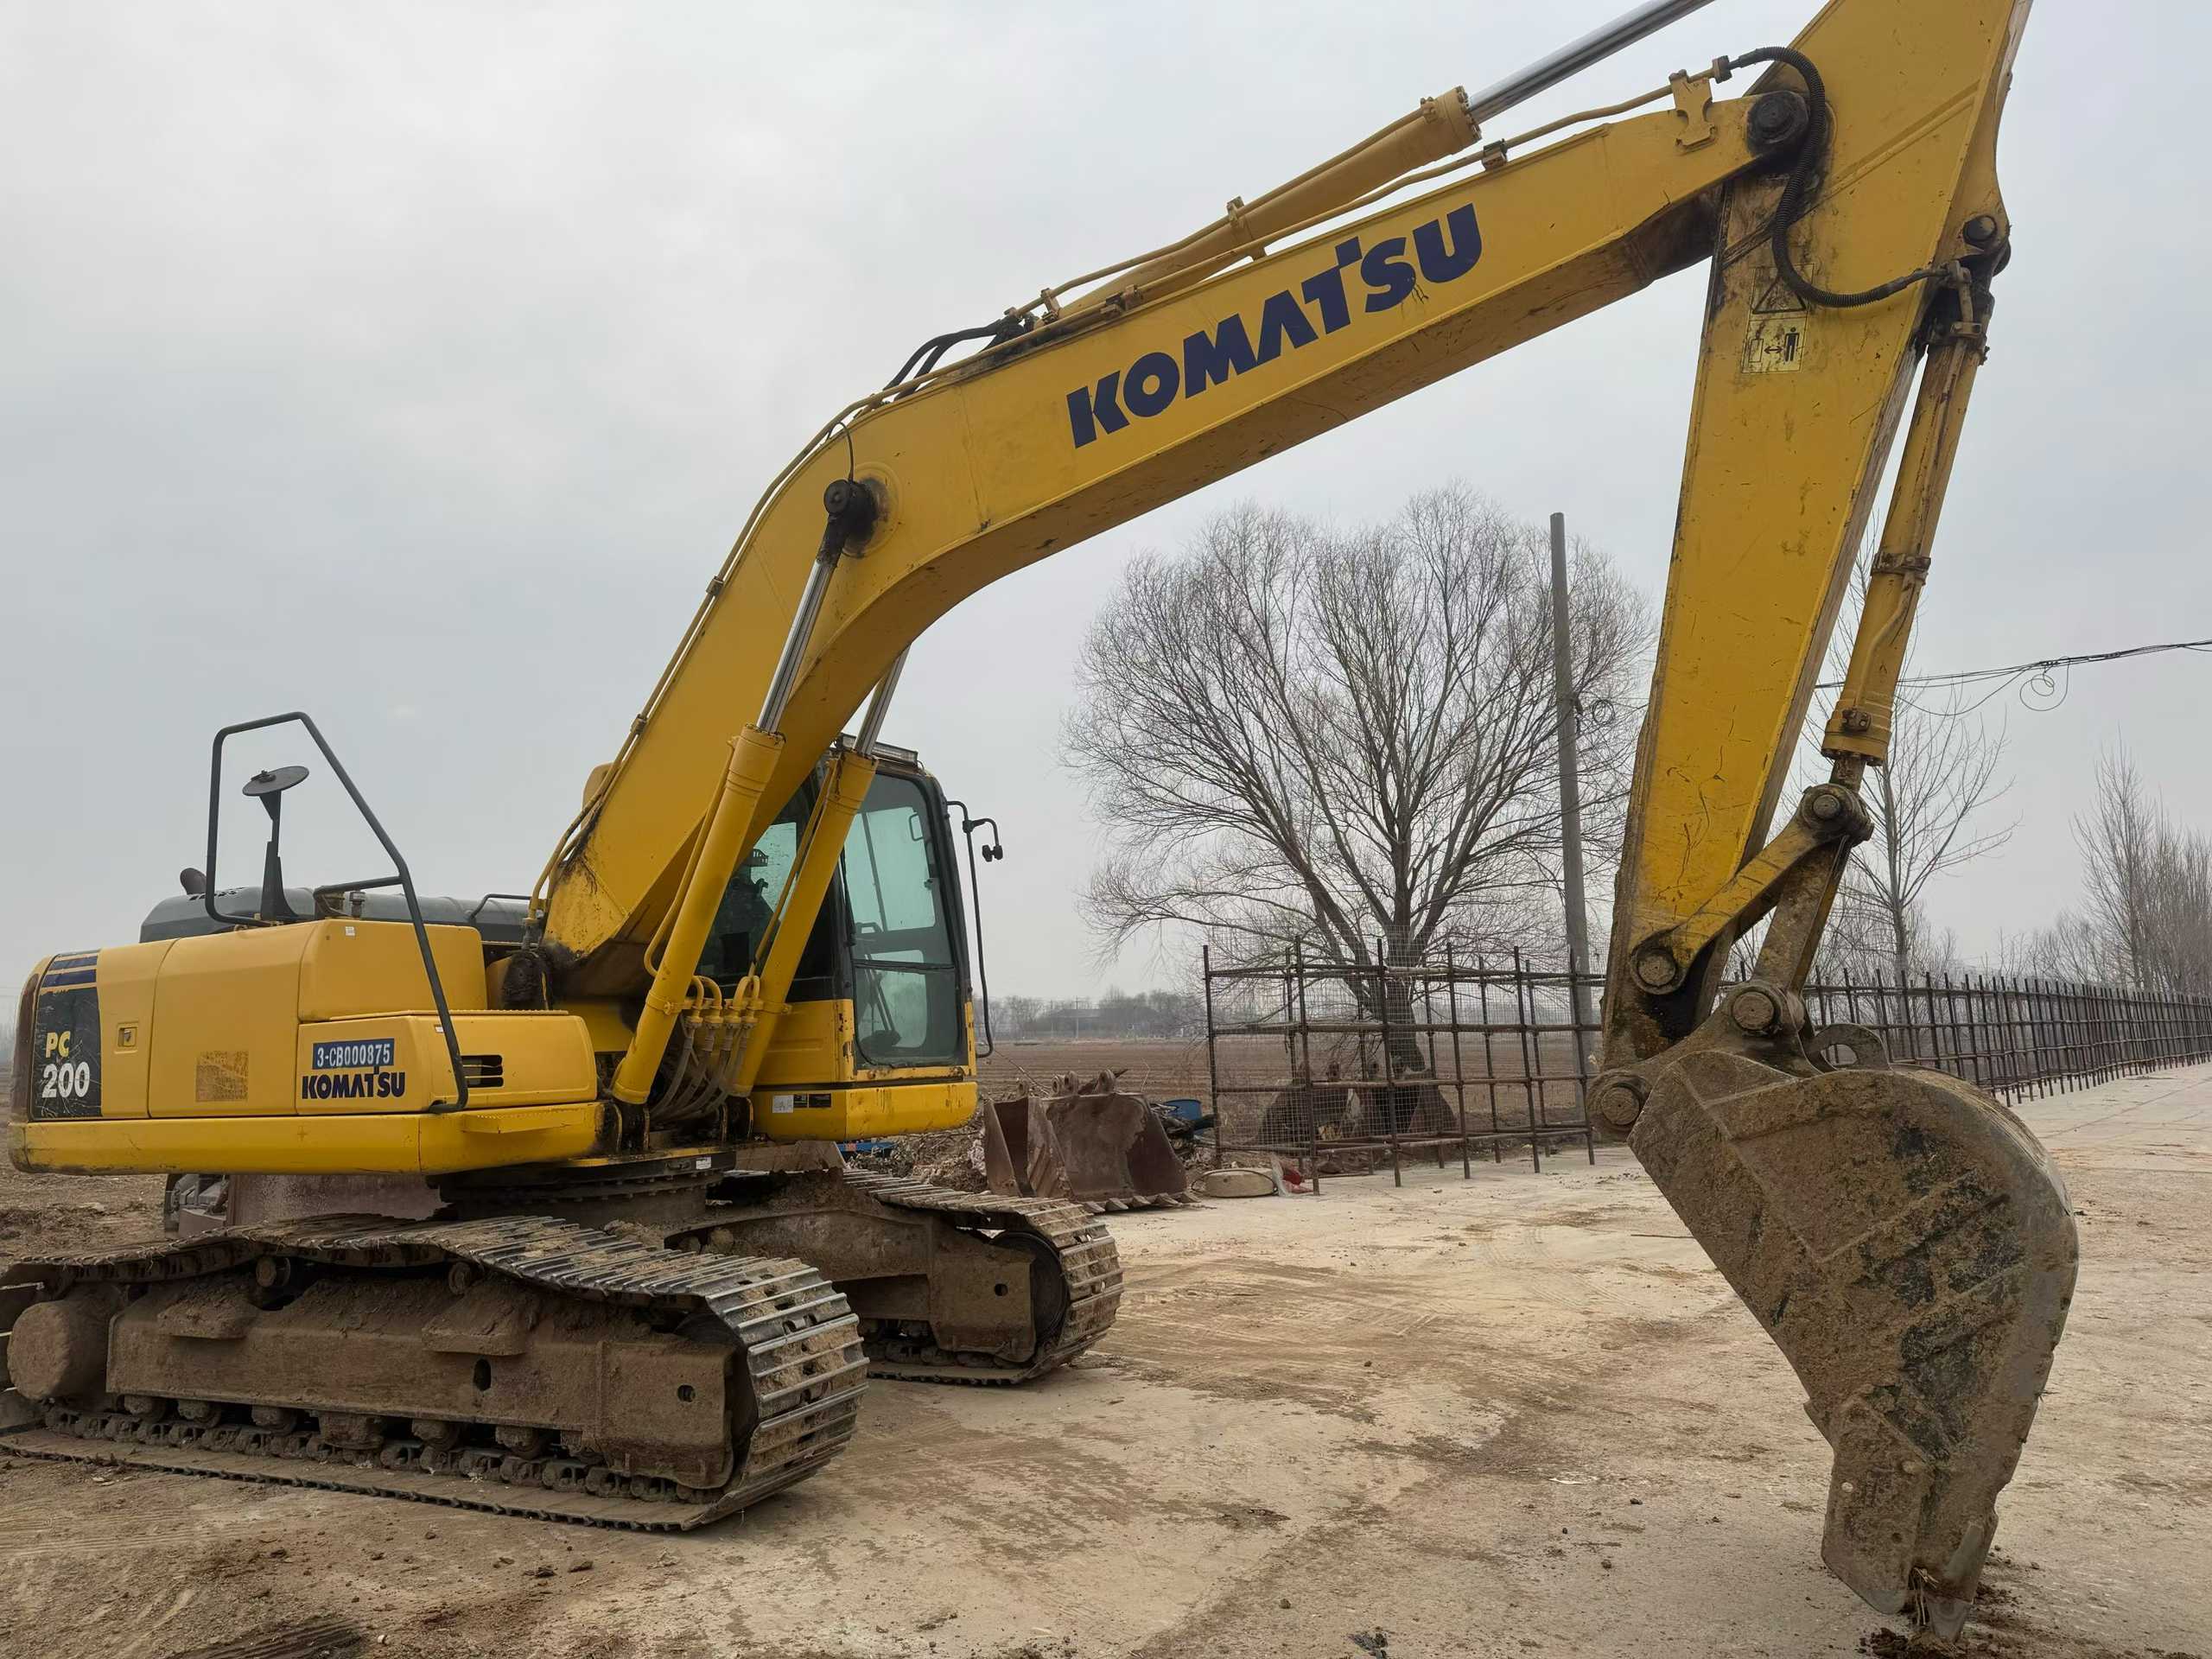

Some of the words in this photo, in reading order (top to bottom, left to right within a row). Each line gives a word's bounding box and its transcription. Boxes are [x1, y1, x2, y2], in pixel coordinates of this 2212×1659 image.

[1066, 203, 1483, 448] KOMATSU
[45, 1030, 71, 1058] PC
[316, 1043, 391, 1068] 3-CB000875
[41, 1061, 91, 1098] 200
[302, 1065, 406, 1100] KOMATSU
